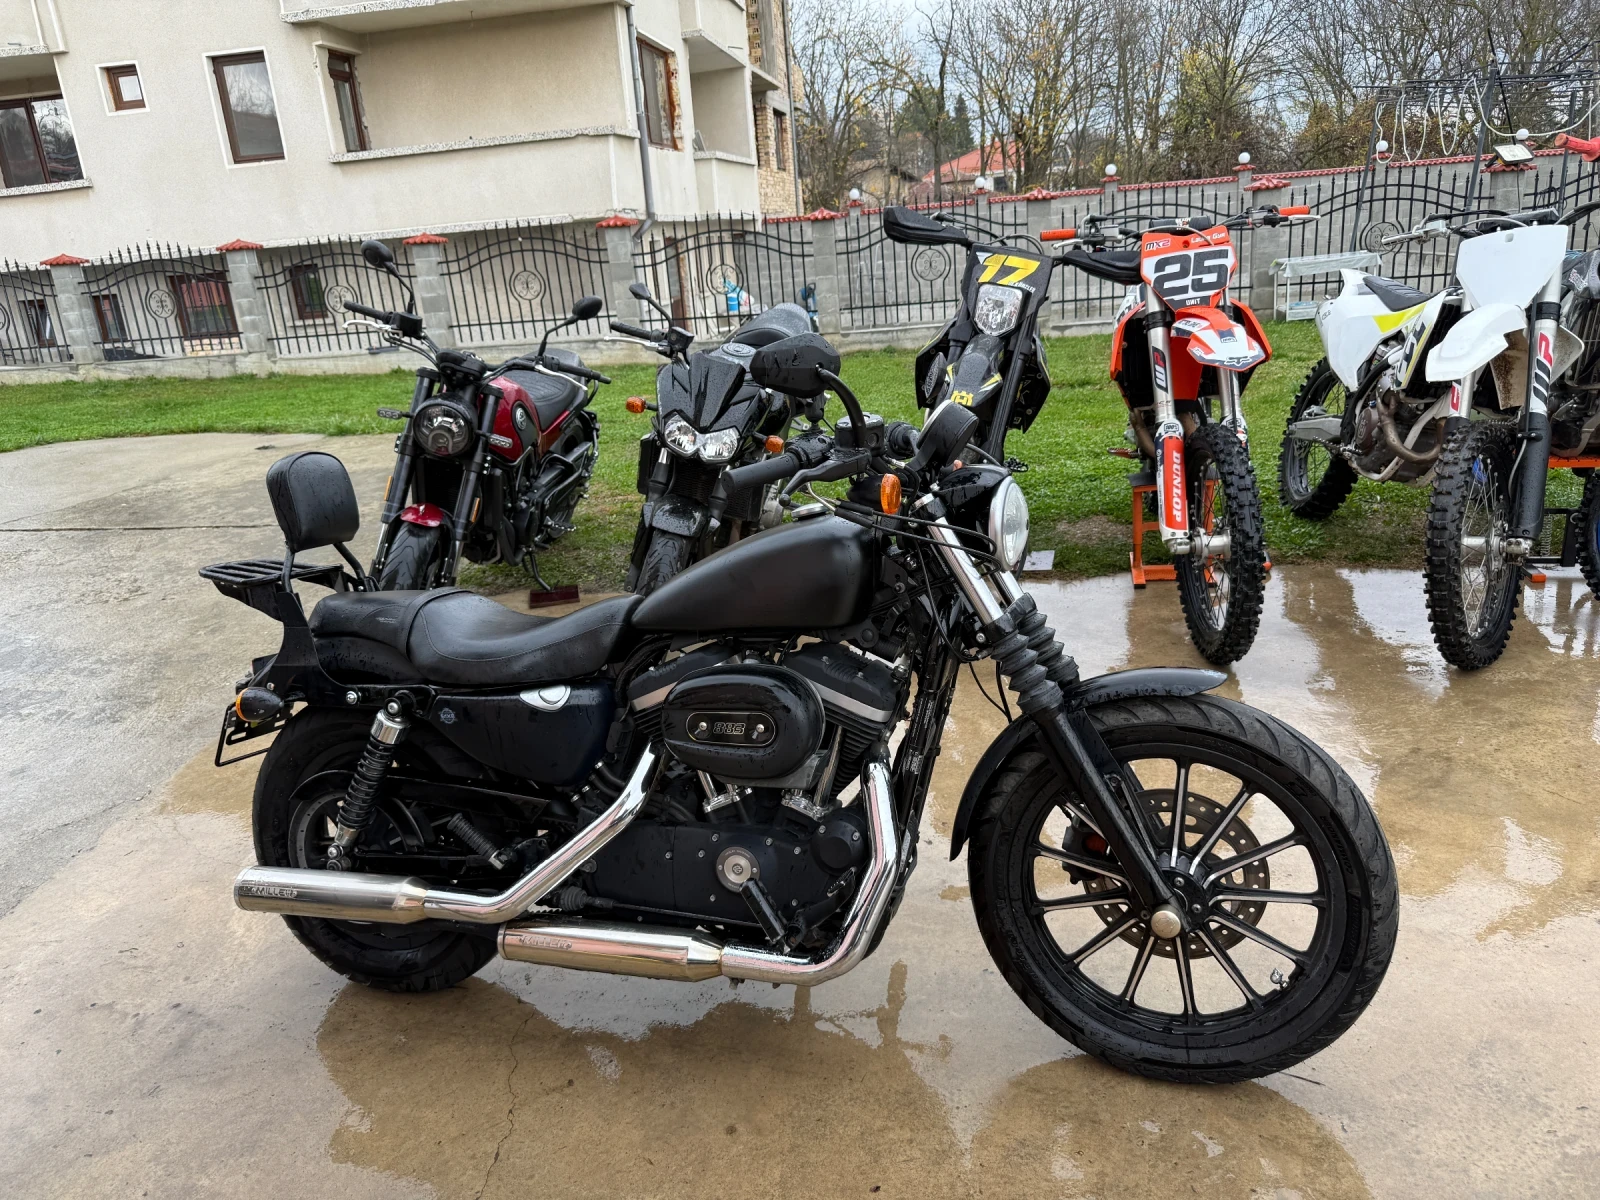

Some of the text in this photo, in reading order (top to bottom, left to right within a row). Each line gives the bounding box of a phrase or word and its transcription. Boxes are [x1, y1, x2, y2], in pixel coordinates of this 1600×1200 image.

[1145, 239, 1170, 251] MX2
[978, 253, 1041, 286] 17
[1153, 248, 1229, 298] 25
[1172, 450, 1183, 523] DUNLOP
